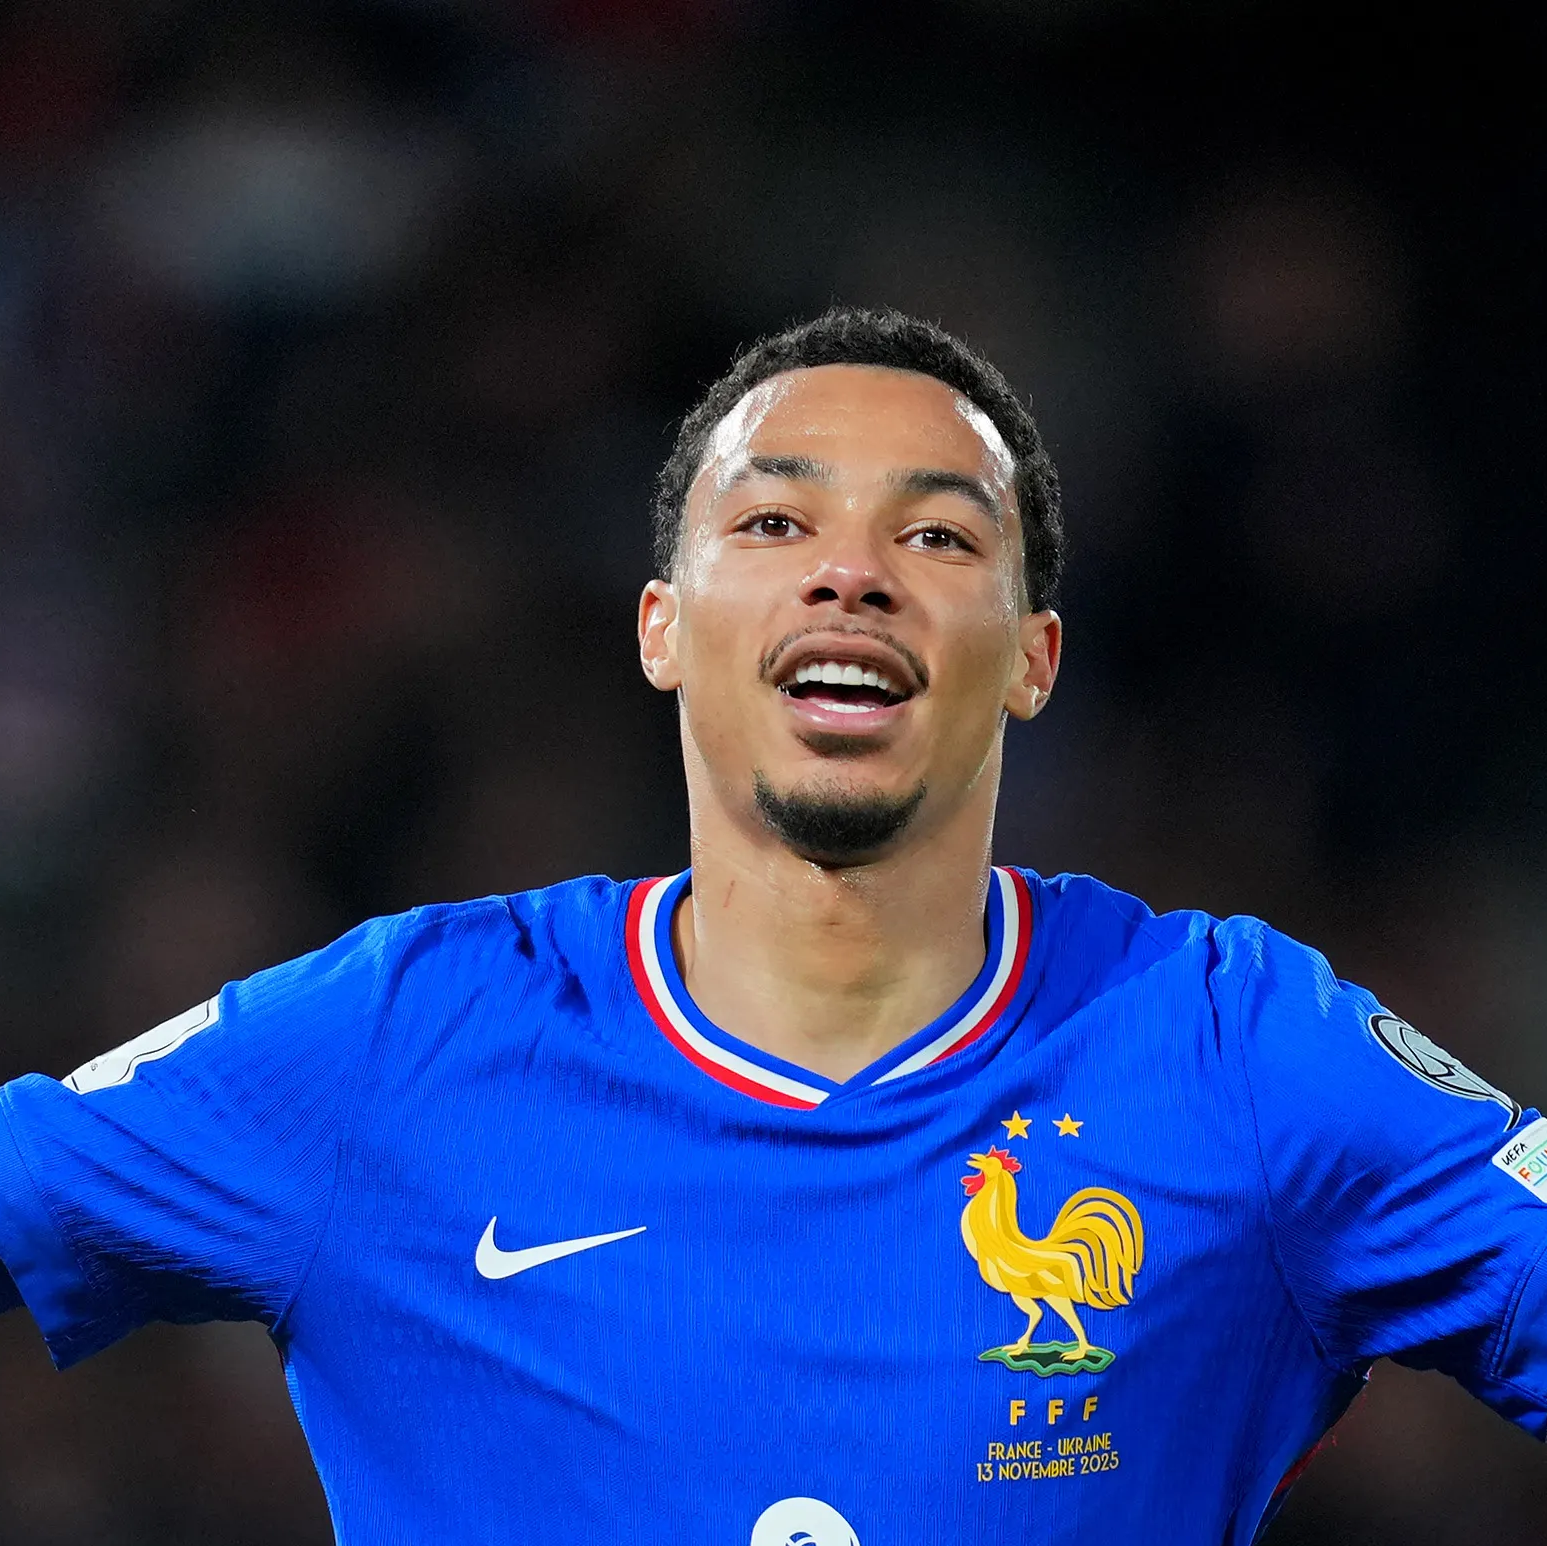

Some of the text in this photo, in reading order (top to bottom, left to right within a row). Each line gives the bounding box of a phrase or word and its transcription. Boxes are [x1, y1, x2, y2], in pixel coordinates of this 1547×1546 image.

[1501, 1142, 1528, 1166] UEFA
[988, 1441, 1042, 1461] FRANCE
[1057, 1432, 1112, 1457] UKRAINE
[976, 1451, 1120, 1482] 13 NOVEMBRE 2025
